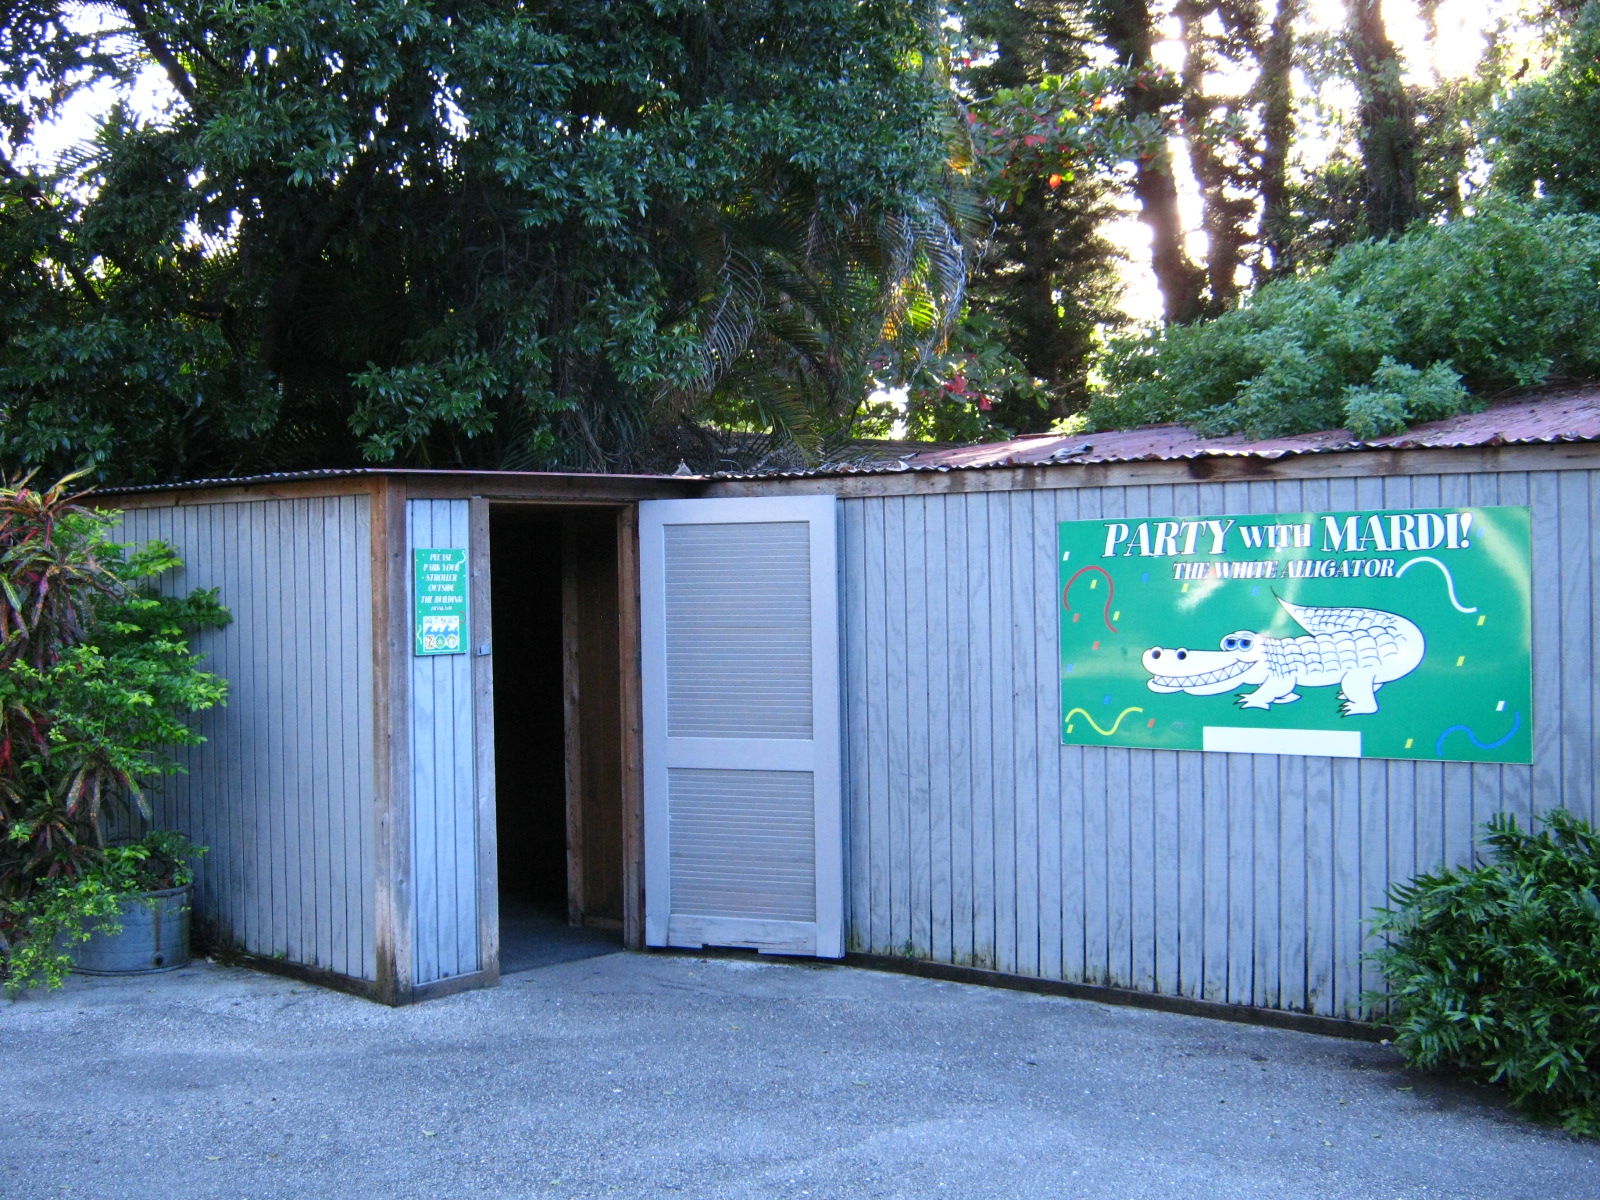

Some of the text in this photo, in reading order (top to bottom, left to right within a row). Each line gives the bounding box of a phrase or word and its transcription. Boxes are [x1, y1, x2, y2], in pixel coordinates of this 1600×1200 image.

[1101, 512, 1474, 558] PARTY WITH MARDI!
[430, 554, 452, 562] PLEASE
[424, 564, 460, 572] PARK YOUR
[1172, 557, 1397, 580] THE WHITE ALLIGATOR
[426, 574, 457, 582] STROLLER
